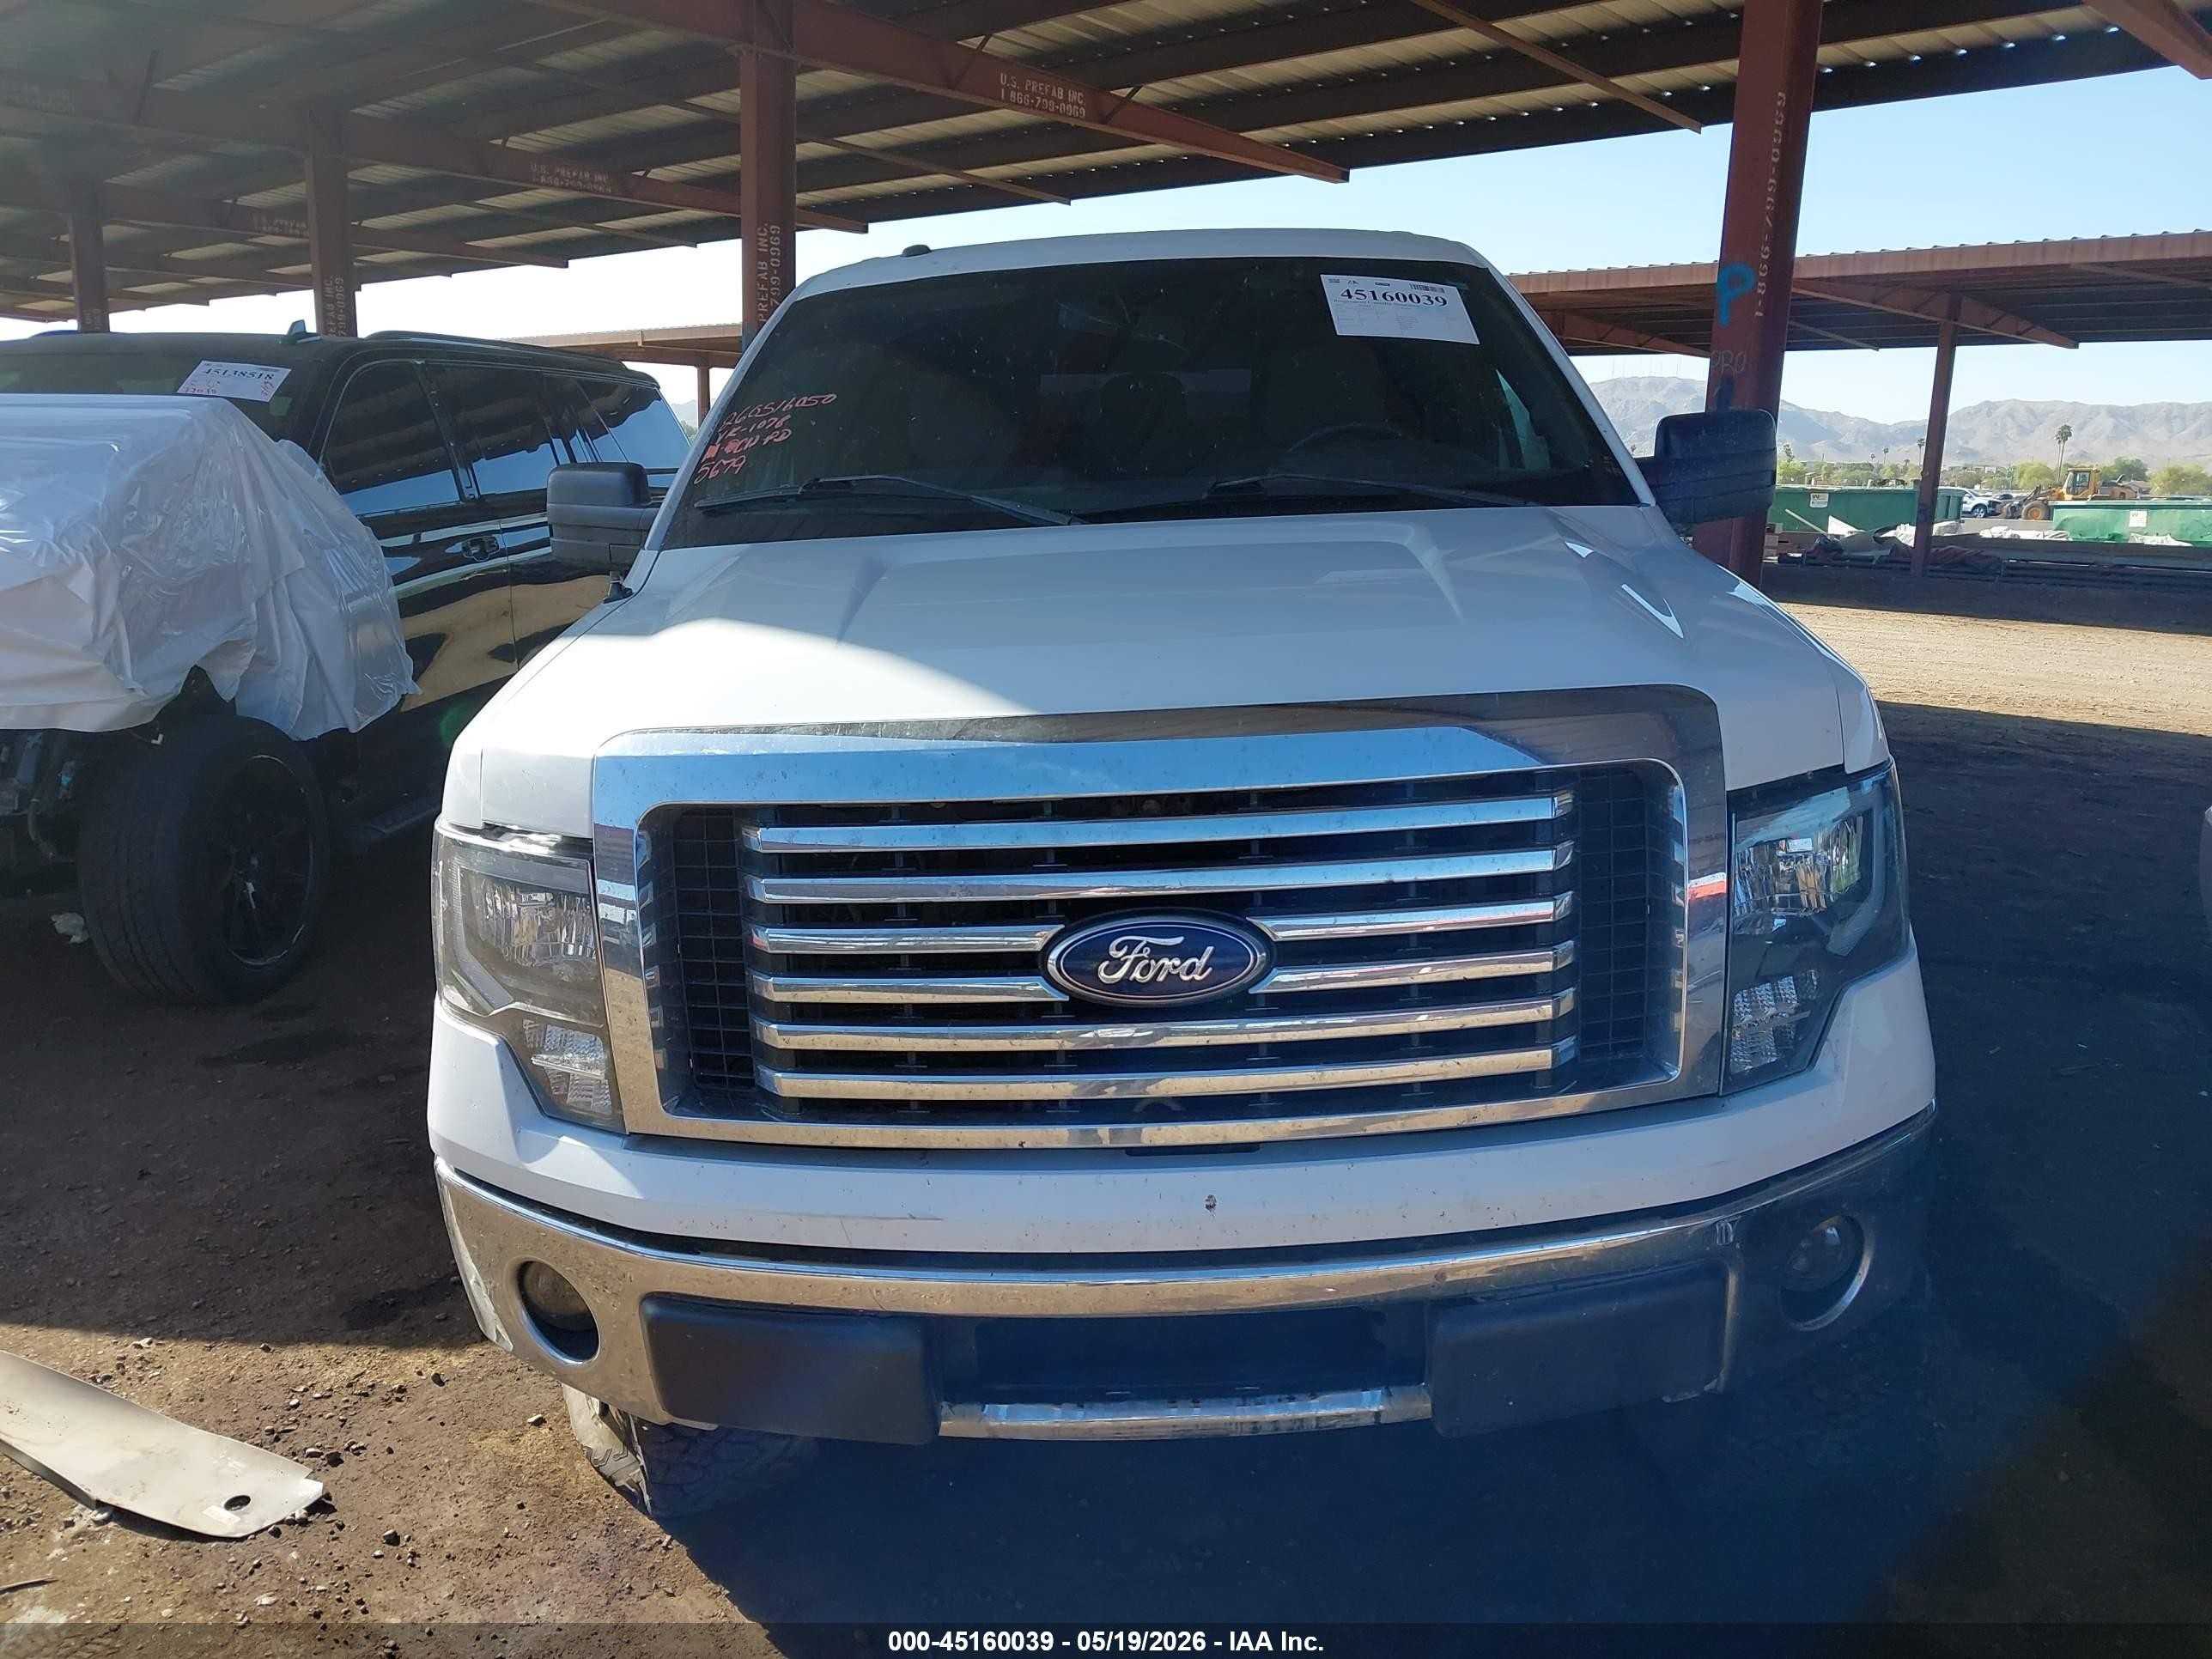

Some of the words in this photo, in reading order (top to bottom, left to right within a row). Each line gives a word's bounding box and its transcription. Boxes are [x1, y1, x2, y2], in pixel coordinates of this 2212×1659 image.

[1000, 72, 1020, 89] U.S.
[1024, 79, 1064, 100] PREFAB
[1068, 89, 1086, 105] INC.
[1755, 92, 1787, 317] 1-866-799-0969
[757, 223, 769, 252] INC.
[1340, 288, 1448, 307] 45160039
[1717, 262, 1756, 326] P
[1097, 935, 1215, 985] Ford
